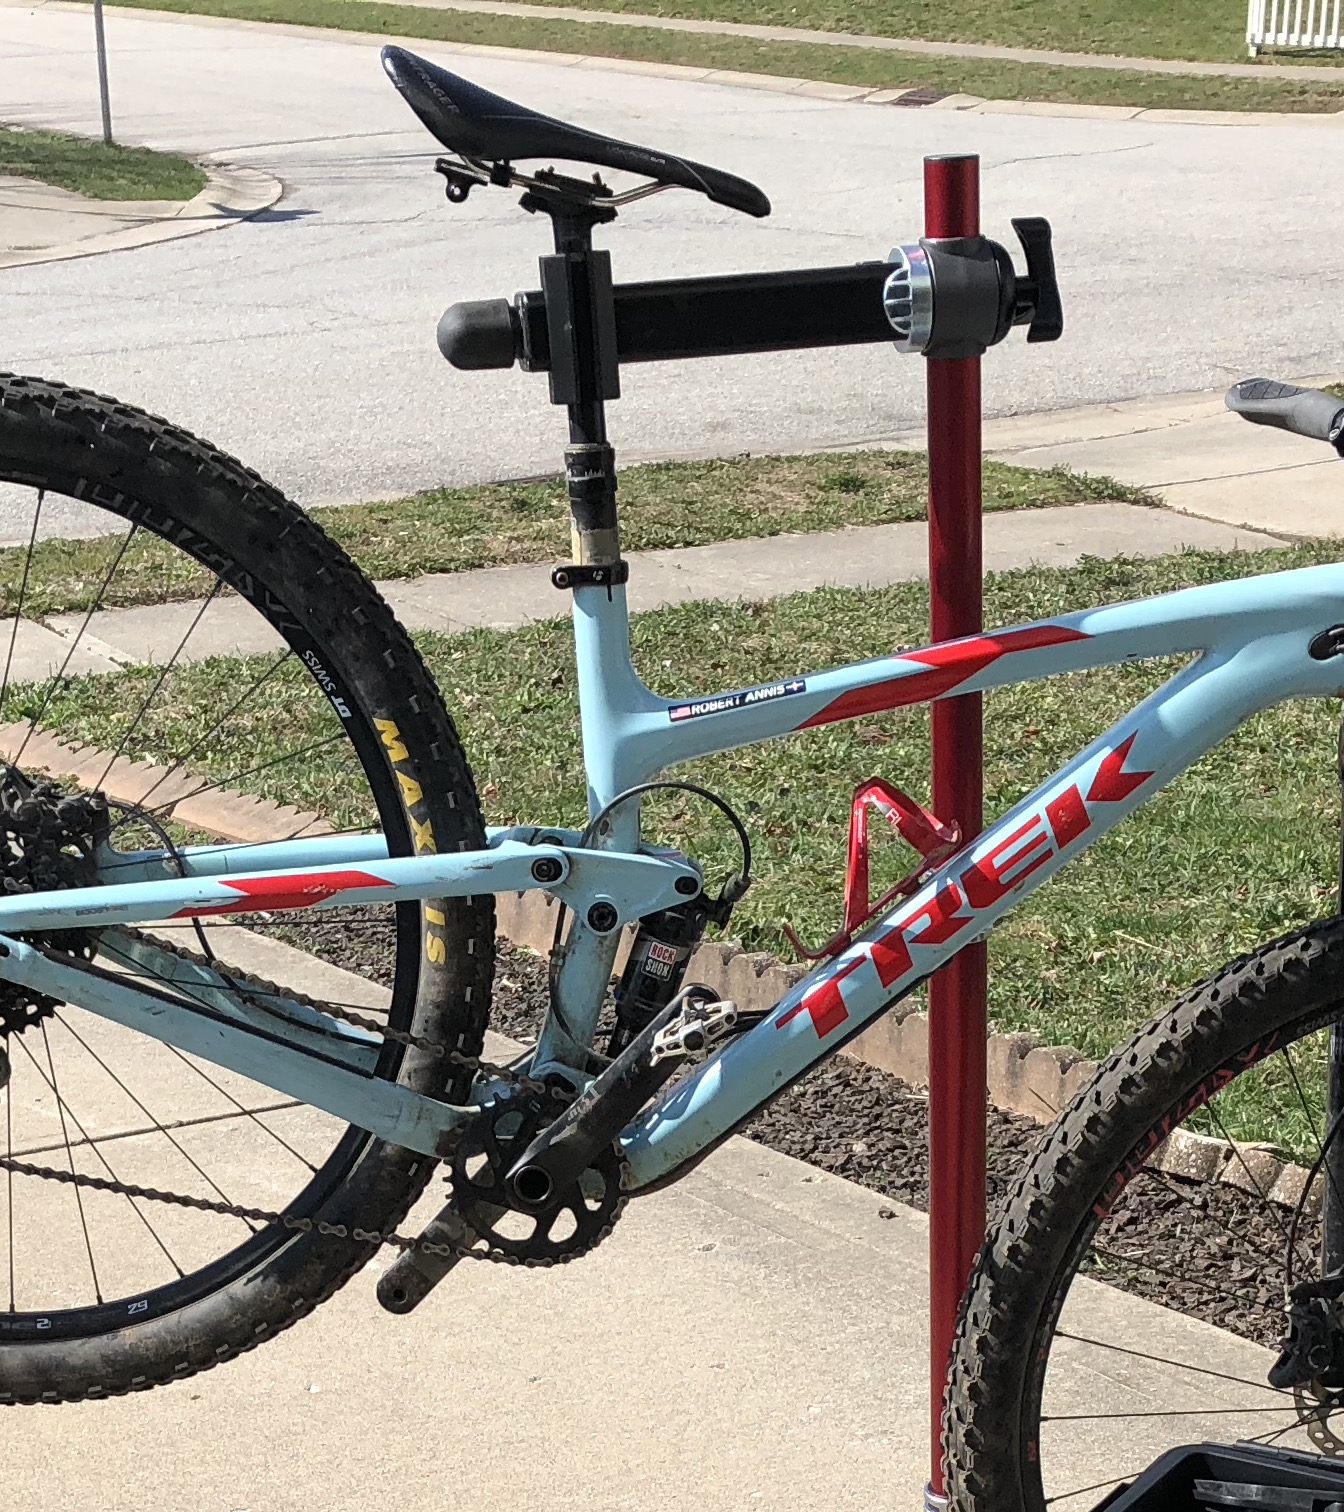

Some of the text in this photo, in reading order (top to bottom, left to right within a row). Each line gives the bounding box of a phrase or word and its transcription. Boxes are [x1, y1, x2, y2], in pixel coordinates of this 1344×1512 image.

[302, 649, 352, 718] DT SWISS
[691, 684, 786, 716] ROBERT ANNIS
[372, 716, 447, 967] MAXIS
[775, 728, 1156, 1039] TREK
[644, 958, 671, 976] SHOX
[650, 943, 677, 963] ROCK
[127, 1299, 148, 1315] 29
